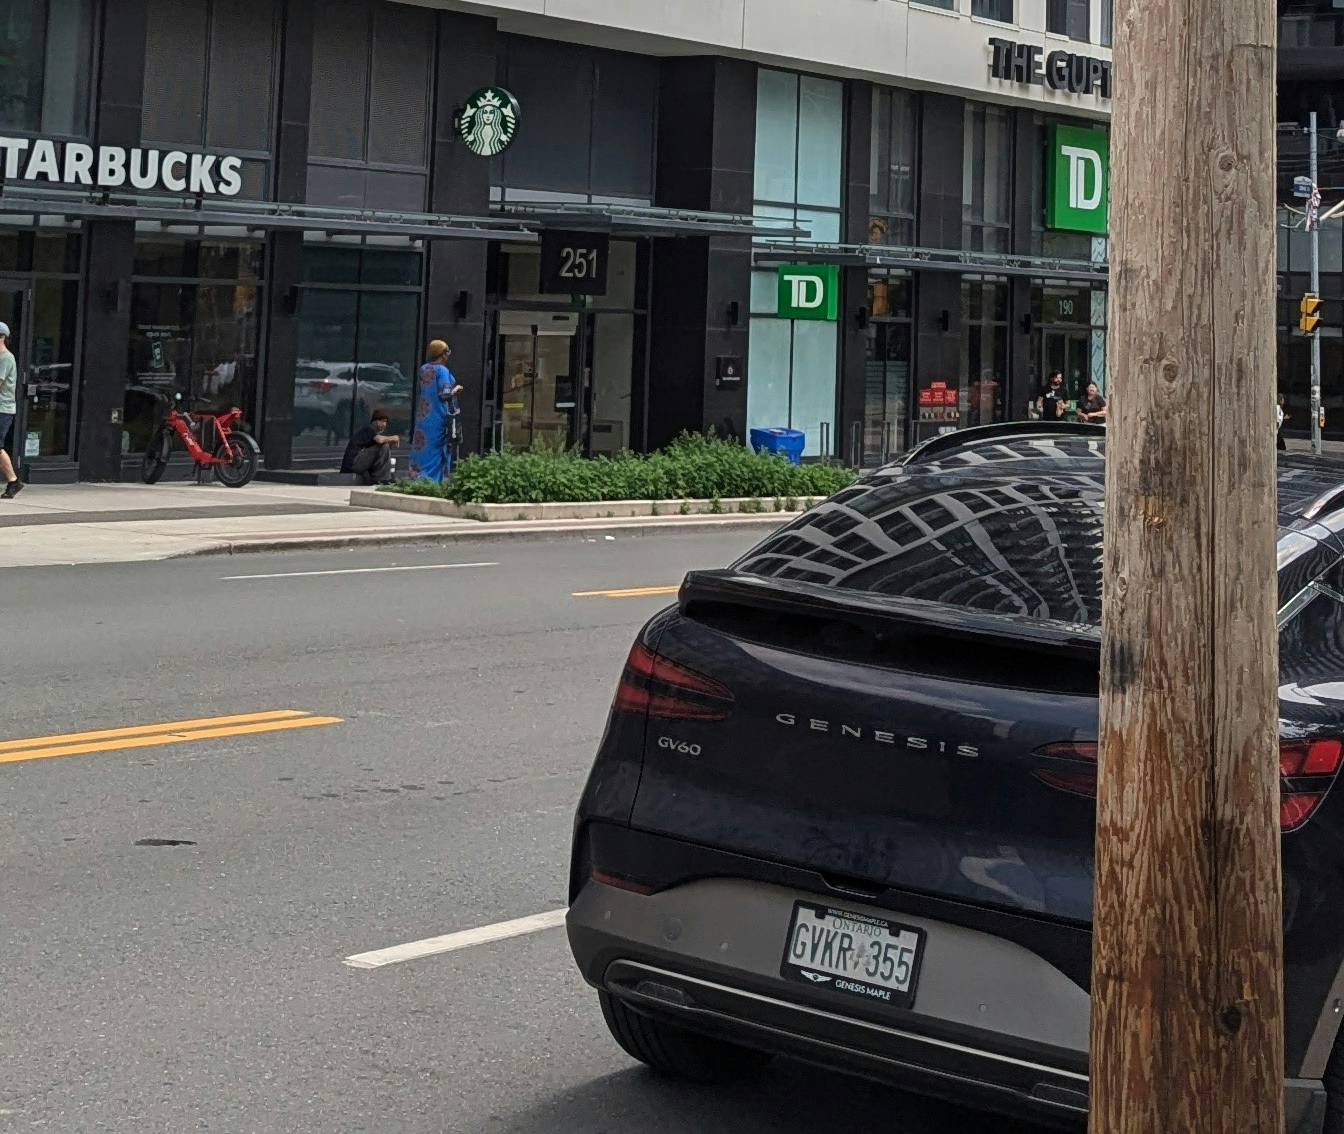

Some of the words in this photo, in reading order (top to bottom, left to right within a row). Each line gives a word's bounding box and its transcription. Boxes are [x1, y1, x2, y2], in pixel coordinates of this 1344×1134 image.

[988, 37, 1044, 85] THE
[1046, 49, 1112, 99] GUPT
[1060, 145, 1103, 210] TD
[559, 247, 598, 278] 251
[783, 274, 824, 308] TD
[1058, 299, 1074, 315] 190
[657, 736, 702, 756] GV60
[775, 713, 979, 758] GENESIS
[832, 917, 882, 938] ONTARIO
[792, 922, 854, 971] GVKR
[864, 940, 914, 985] 355
[835, 979, 866, 994] GENESIS
[867, 987, 892, 1001] MAPLE
